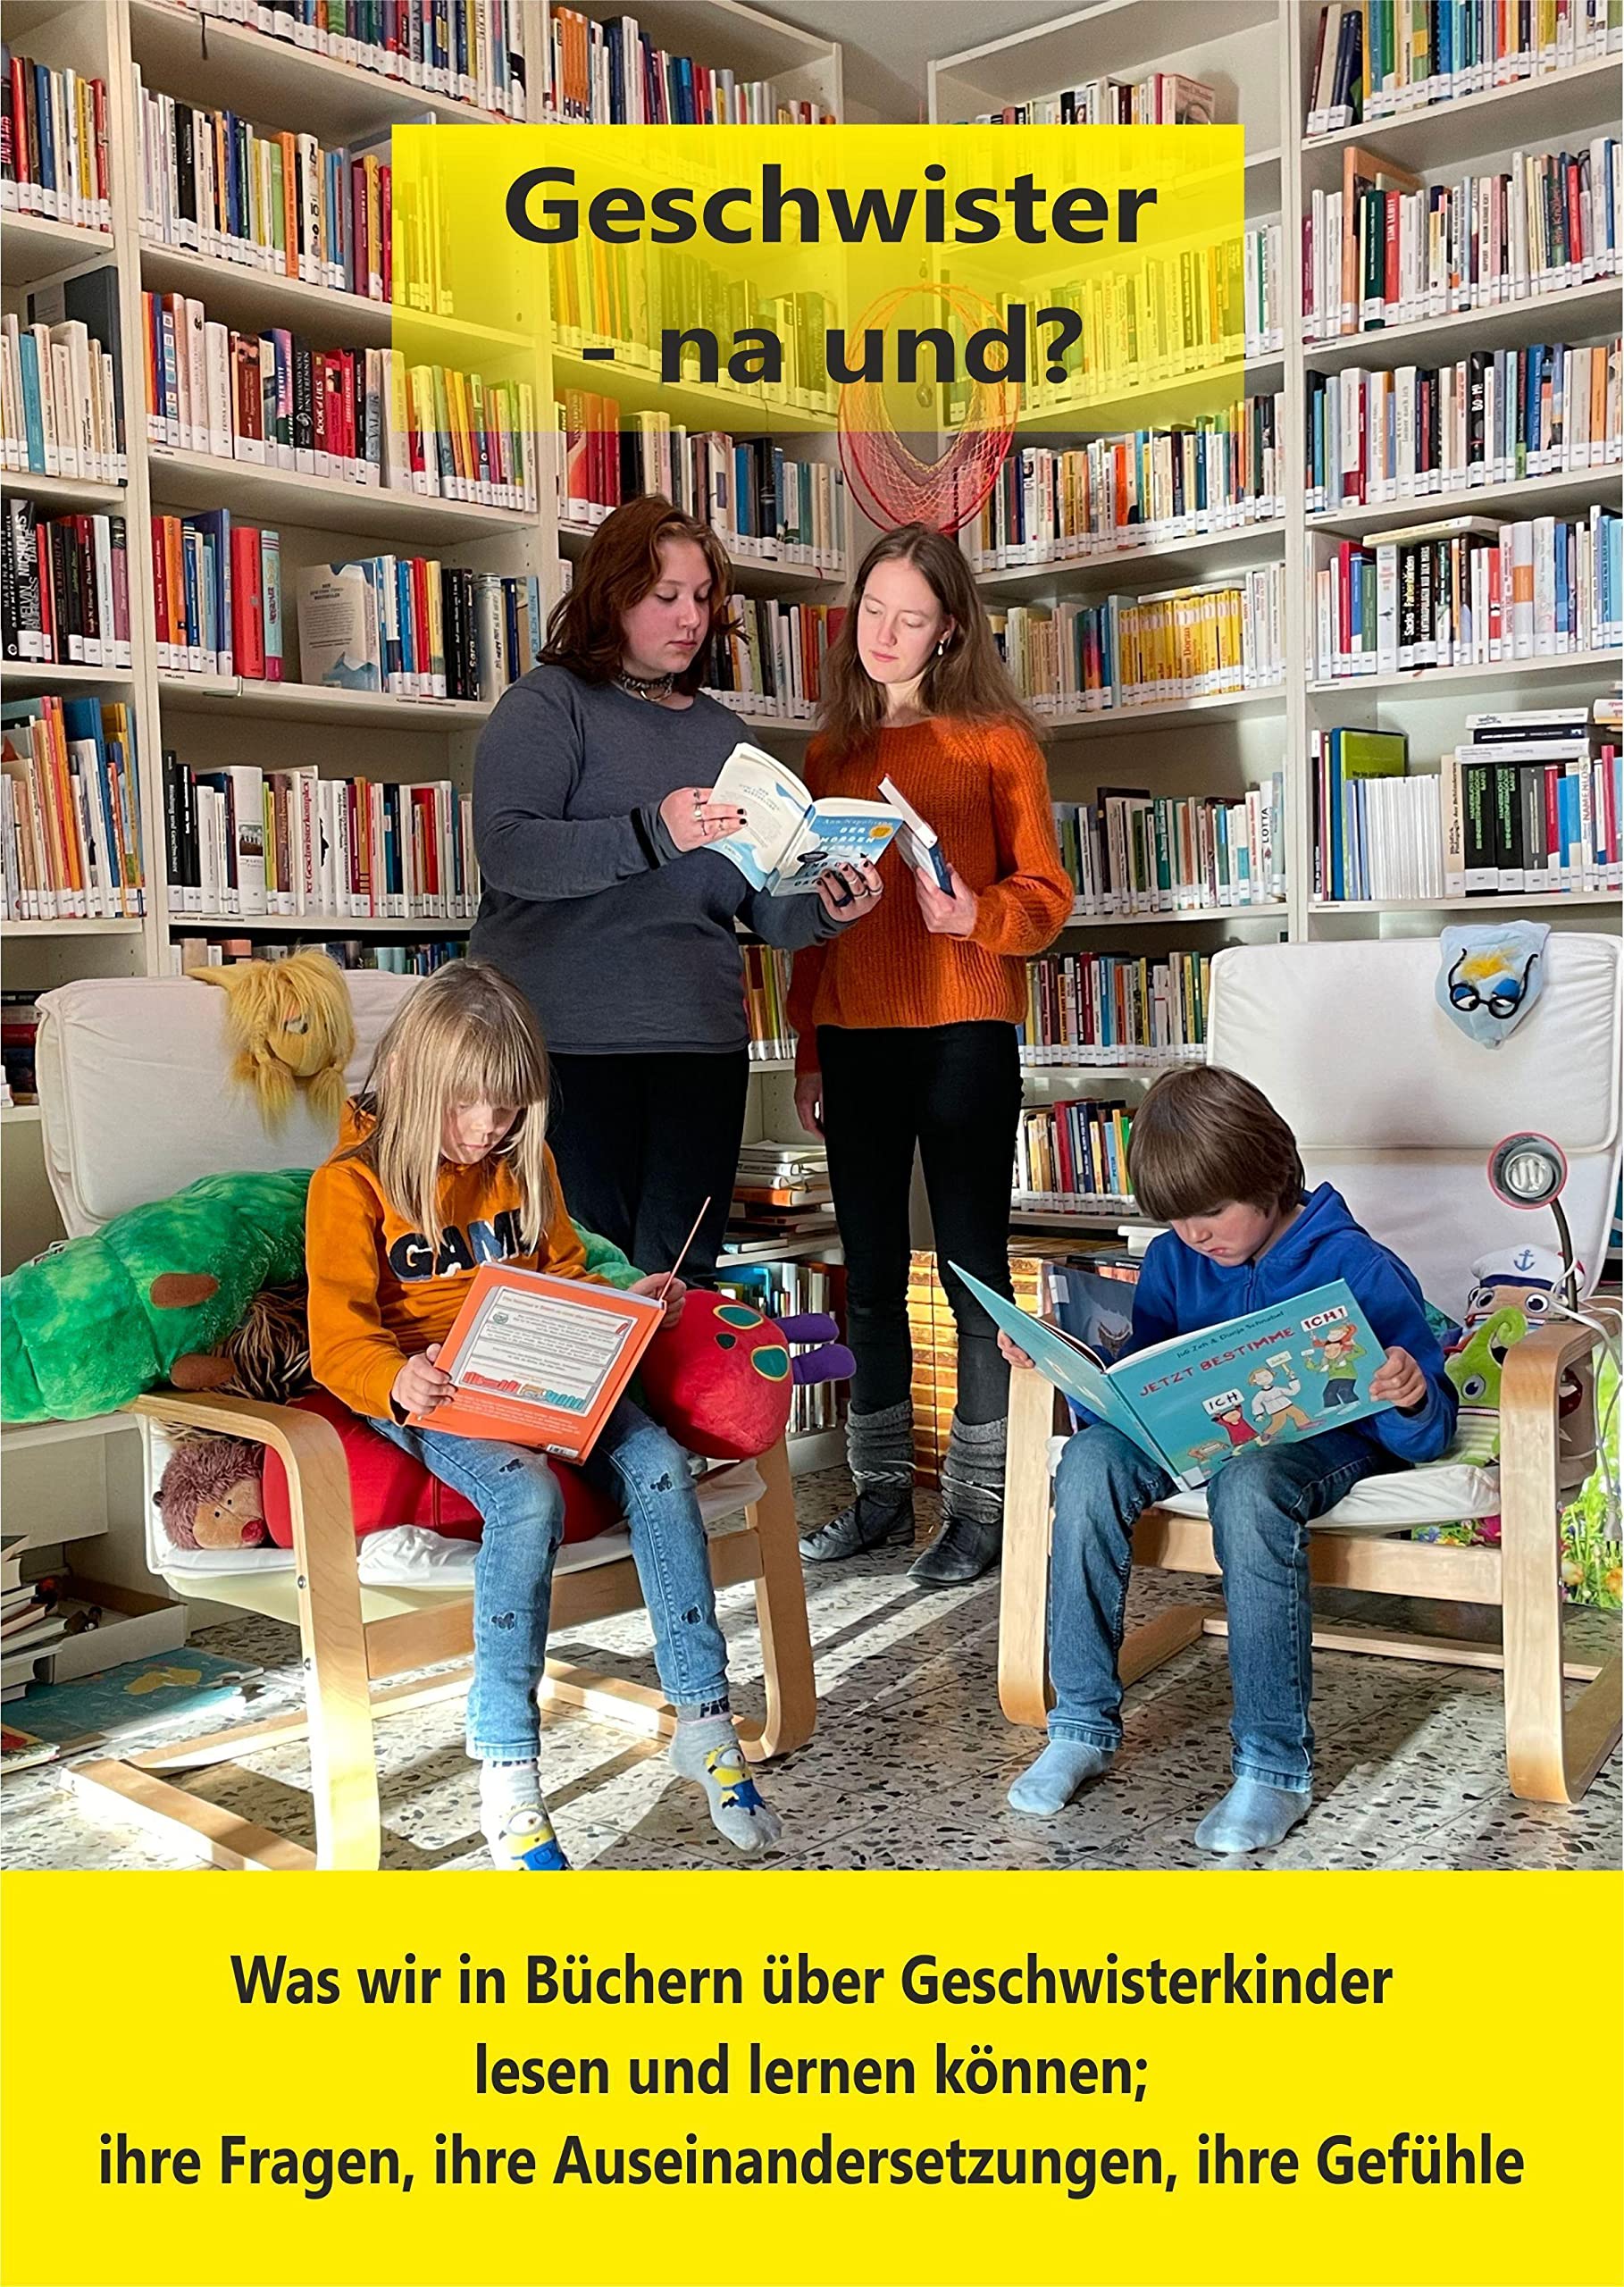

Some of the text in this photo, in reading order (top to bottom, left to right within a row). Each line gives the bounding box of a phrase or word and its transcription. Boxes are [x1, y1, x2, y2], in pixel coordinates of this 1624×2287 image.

[314, 380, 324, 400] LIES
[315, 411, 325, 435] BOOK
[14, 514, 34, 625] MELVIN NICHOLAS
[26, 528, 41, 630] BURGESS DANE
[1403, 555, 1415, 636] Sacks Farbenblinden
[1260, 808, 1269, 843] LOTTA
[1579, 763, 1591, 821] NAMENLOS
[303, 781, 313, 880] Geschwisterkomplex
[389, 1209, 539, 1283] GAM
[1139, 1307, 1345, 1397] JETZT BESTIMME ICH!
[1209, 1391, 1238, 1410] ICH
